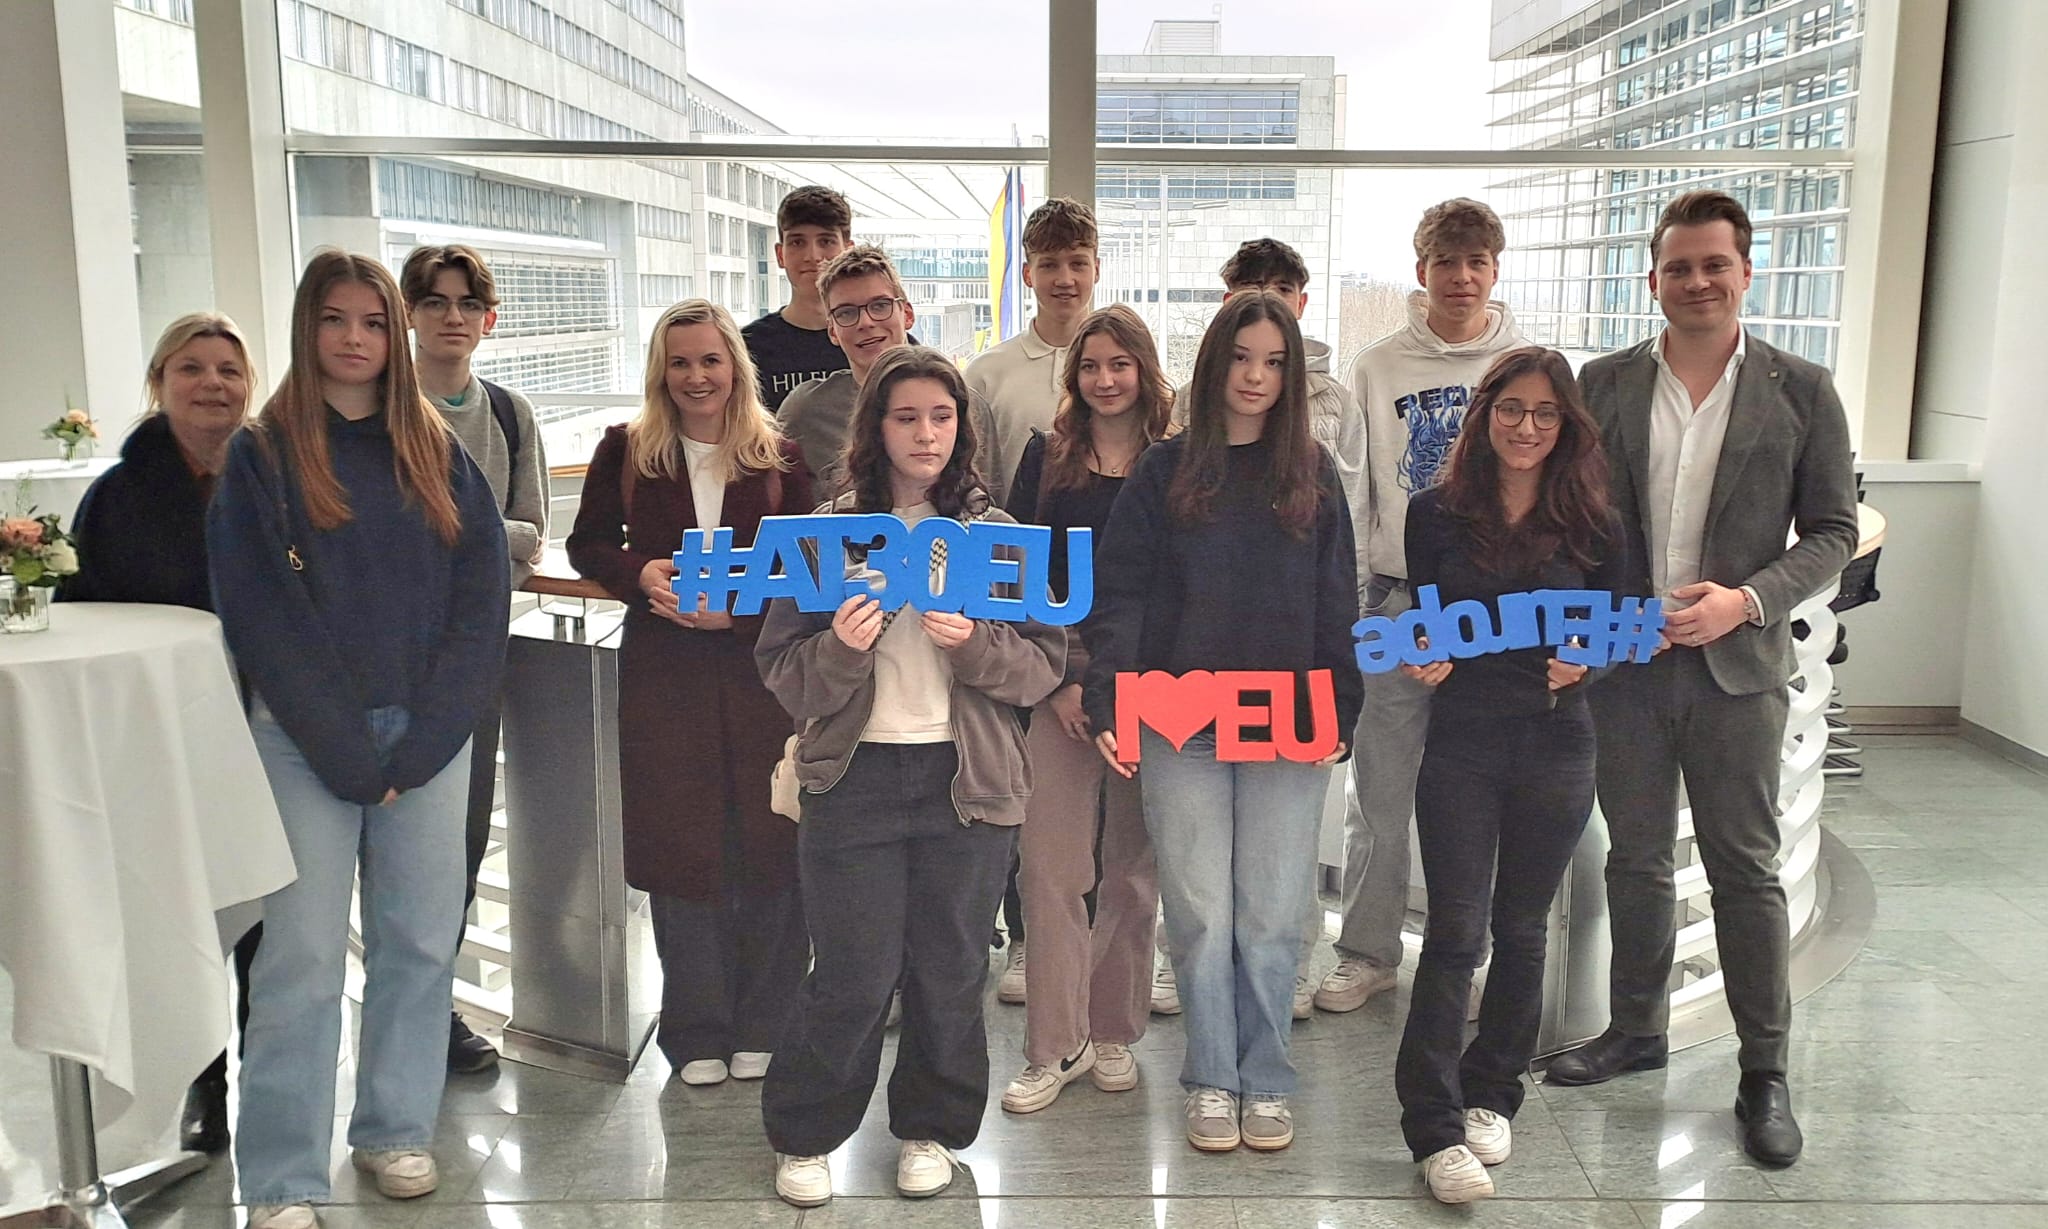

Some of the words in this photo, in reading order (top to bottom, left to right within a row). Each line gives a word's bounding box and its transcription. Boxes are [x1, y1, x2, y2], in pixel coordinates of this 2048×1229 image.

[671, 513, 1093, 626] #AT30EU
[1351, 583, 1665, 674] #Europe
[1215, 668, 1339, 762] EU
